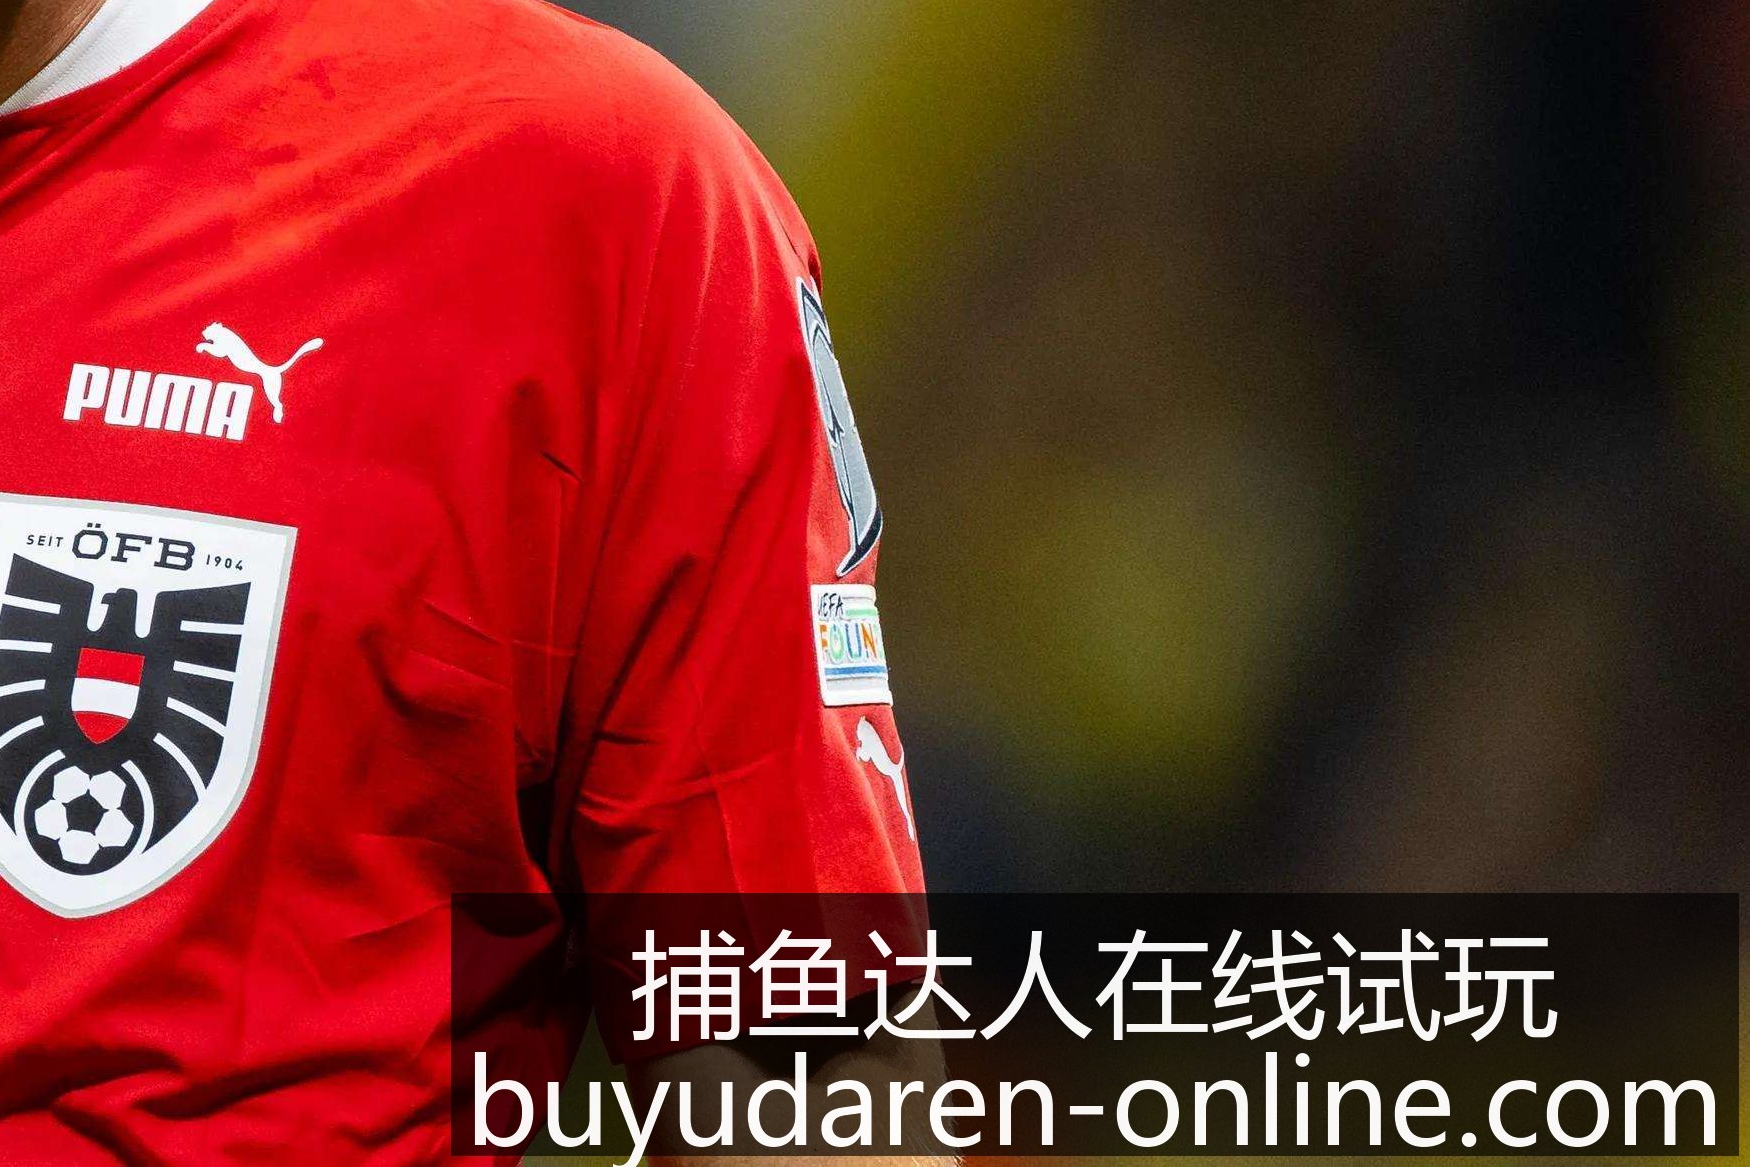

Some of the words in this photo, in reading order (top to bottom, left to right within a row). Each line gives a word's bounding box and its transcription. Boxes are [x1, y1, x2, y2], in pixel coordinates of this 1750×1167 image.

[63, 362, 254, 442] PUMA
[26, 533, 64, 548] SEIT
[71, 522, 196, 571] ÖFB
[205, 554, 244, 571] 1904
[819, 622, 885, 662] FOUN
